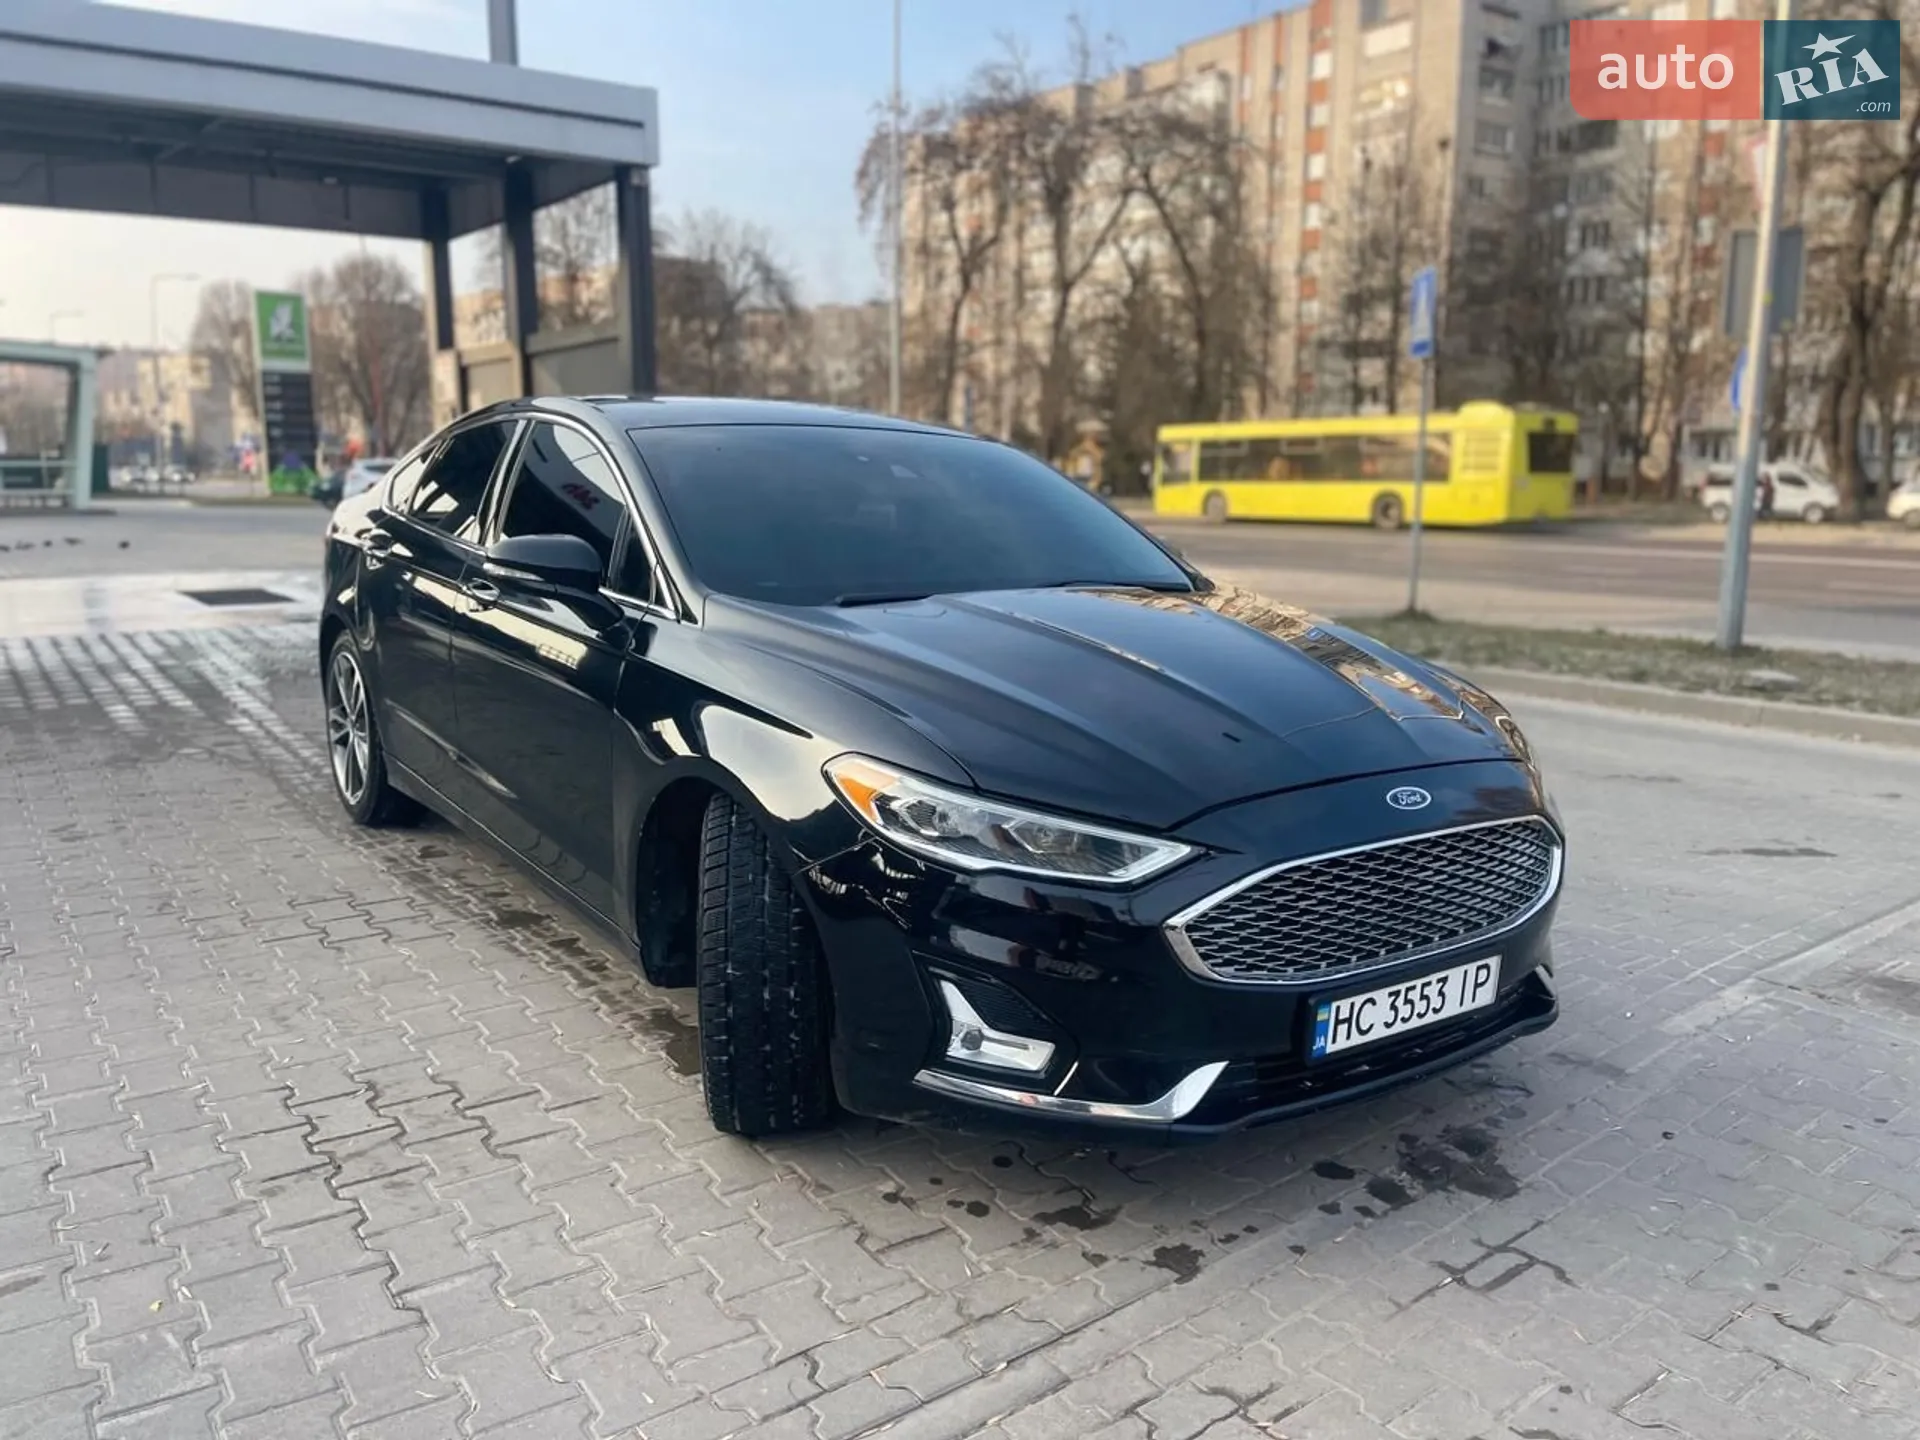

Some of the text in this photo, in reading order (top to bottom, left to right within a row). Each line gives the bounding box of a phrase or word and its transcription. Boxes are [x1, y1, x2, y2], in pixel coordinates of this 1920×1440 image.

[1397, 791, 1422, 805] Ford
[1331, 963, 1491, 1045] HC 3553 IP
